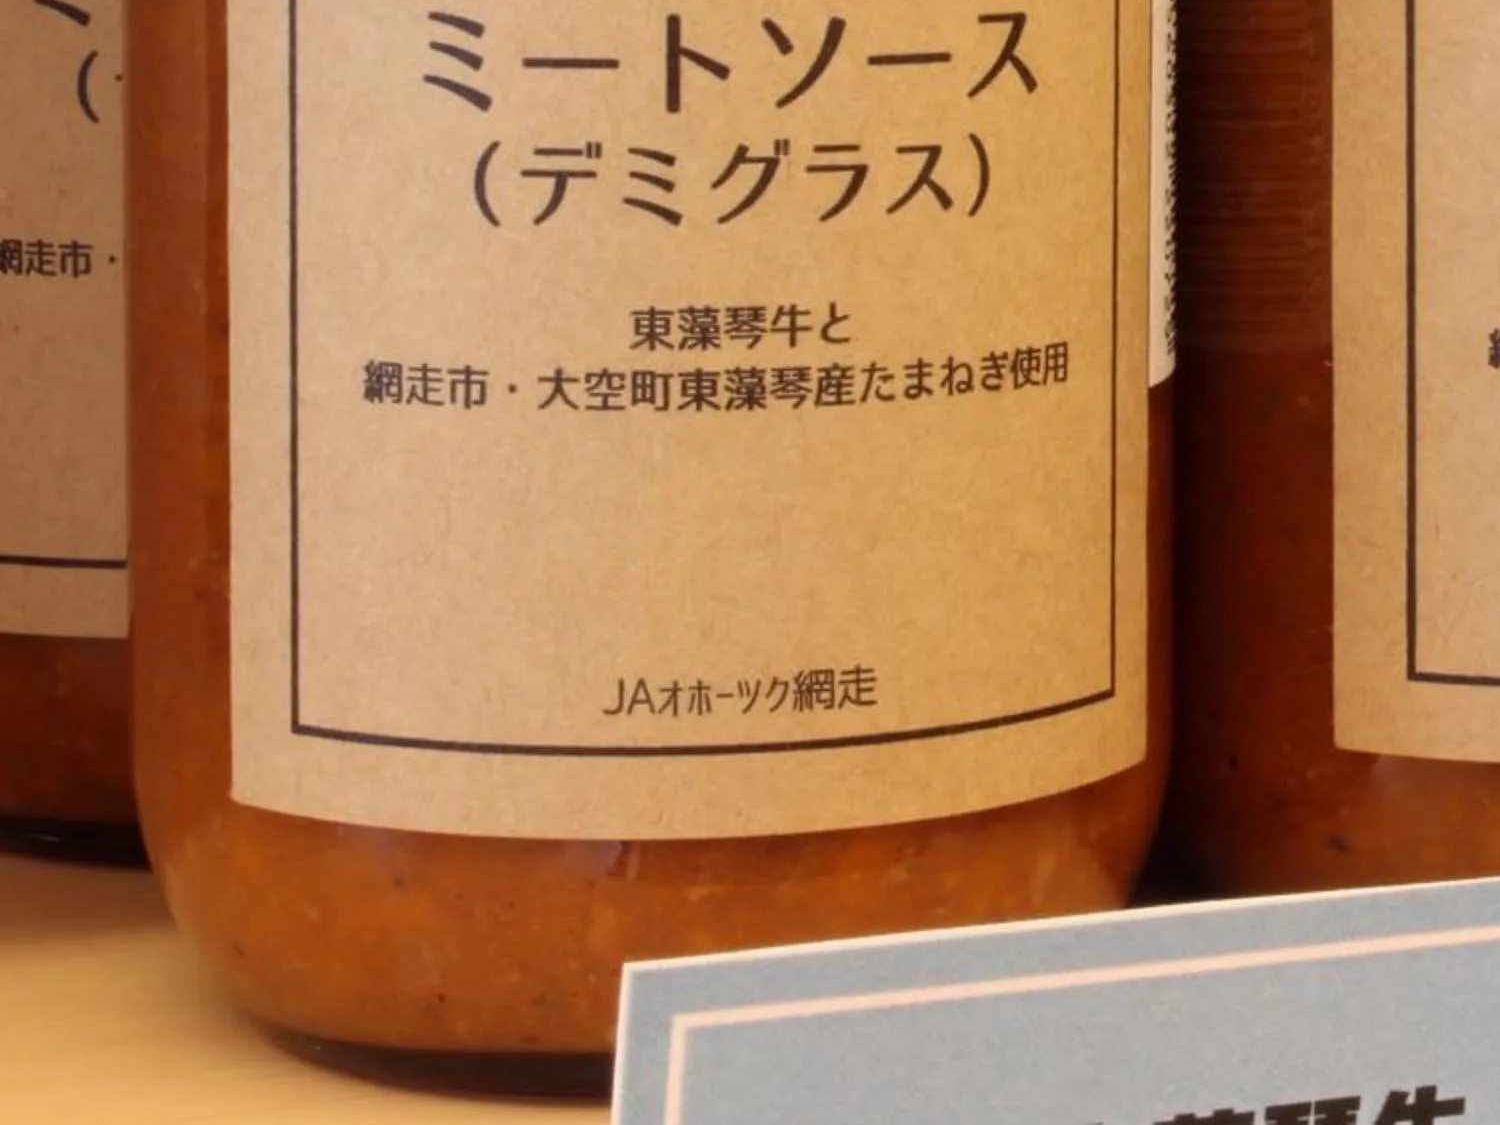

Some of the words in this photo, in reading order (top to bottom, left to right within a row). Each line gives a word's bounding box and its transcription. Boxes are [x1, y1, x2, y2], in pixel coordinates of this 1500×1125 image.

[423, 10, 1039, 114] ミートソース
[473, 132, 991, 227] （デミグラス）
[629, 302, 852, 351] 東藻琴牛と
[363, 341, 1069, 412] 網走市・大空町東藻琴産たまねぎ使用
[602, 665, 878, 718] JAオホーツク網走
